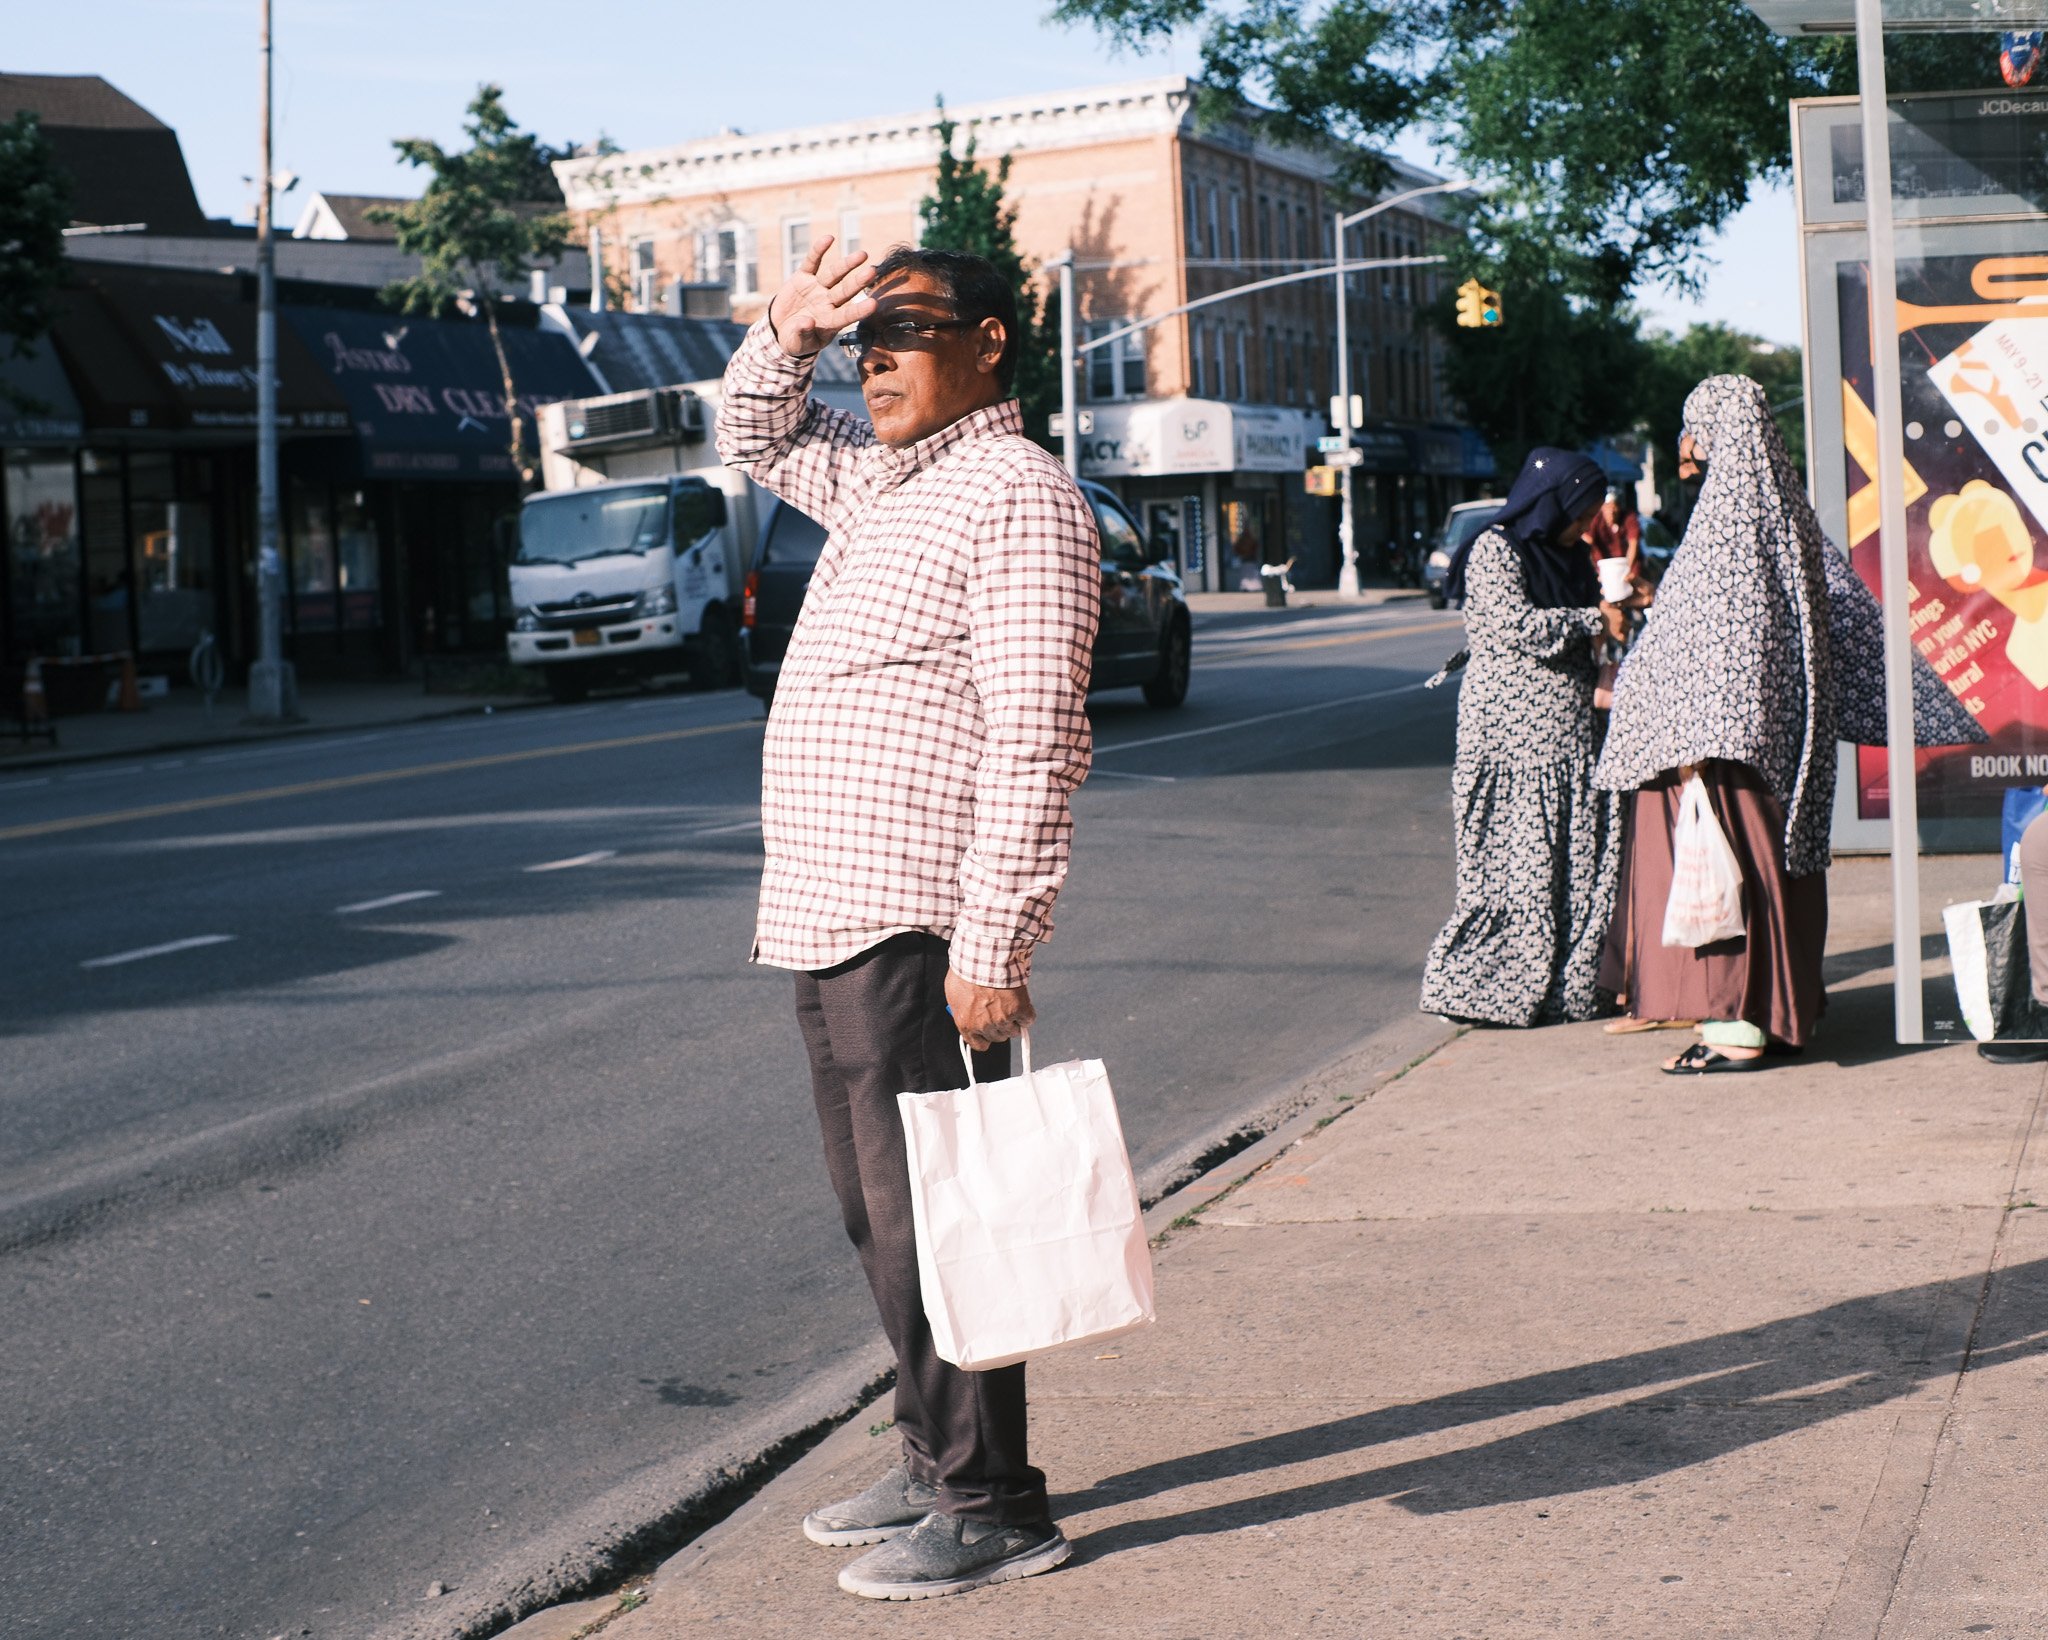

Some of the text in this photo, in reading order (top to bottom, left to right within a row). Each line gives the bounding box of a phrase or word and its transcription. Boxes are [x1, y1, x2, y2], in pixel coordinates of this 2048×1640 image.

[1995, 333, 2021, 359] MAY
[373, 382, 437, 415] DRY
[1932, 614, 1964, 646] your
[1963, 619, 1998, 652] NYC
[1971, 755, 2022, 778] BOOK
